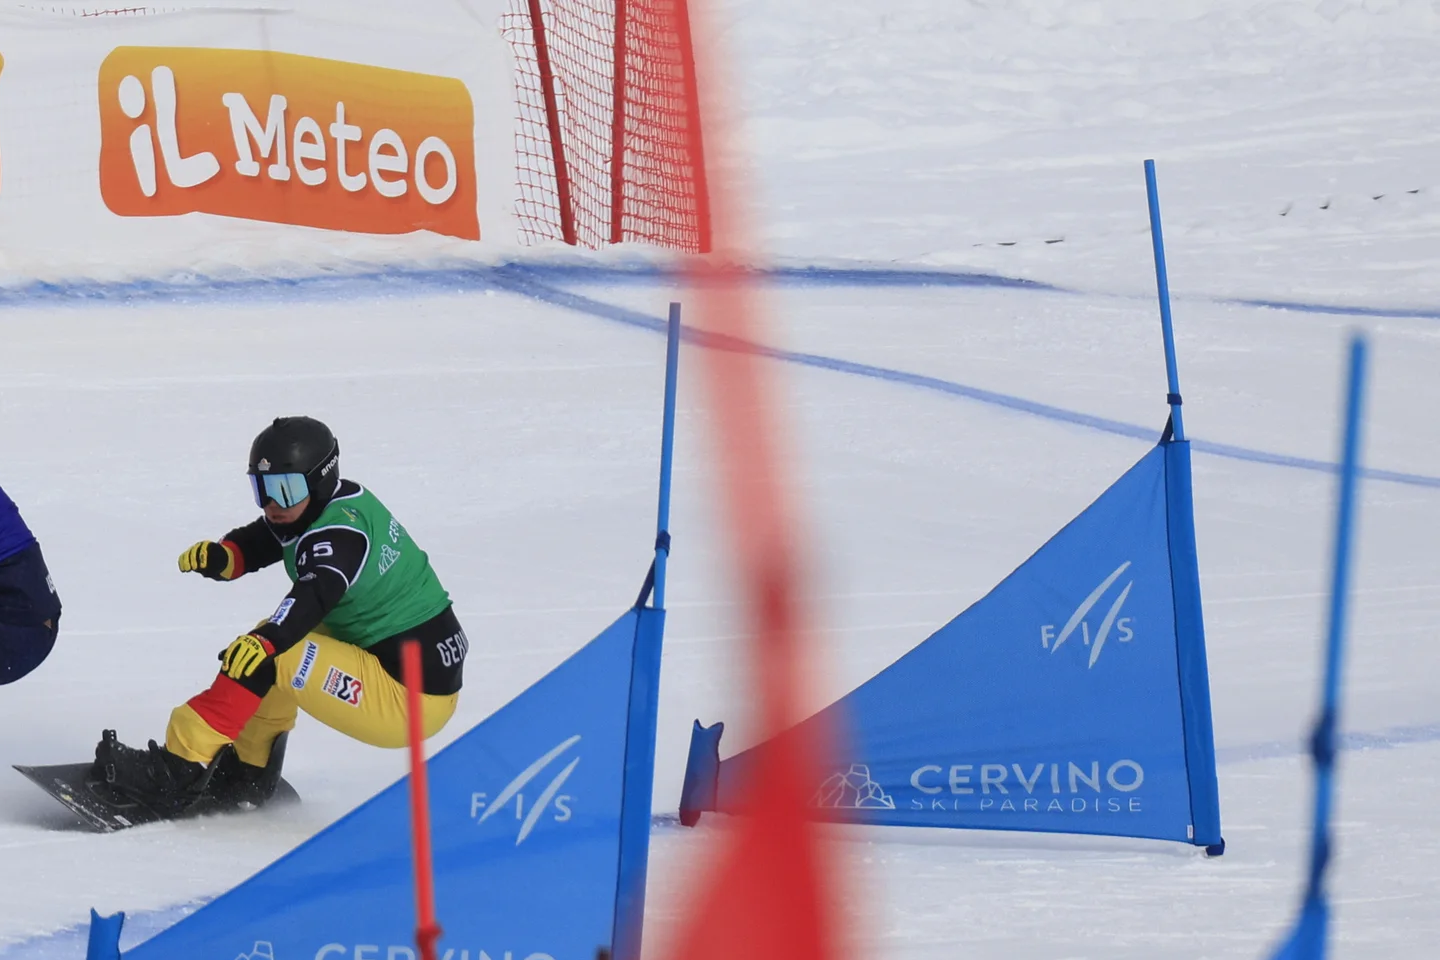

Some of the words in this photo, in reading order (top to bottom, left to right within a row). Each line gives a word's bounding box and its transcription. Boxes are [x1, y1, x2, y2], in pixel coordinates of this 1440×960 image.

[222, 92, 457, 205] Meteo
[299, 642, 317, 677] Allianz
[910, 759, 1144, 794] CERVINO
[911, 798, 960, 812] SKI
[980, 797, 1142, 812] PARADISE
